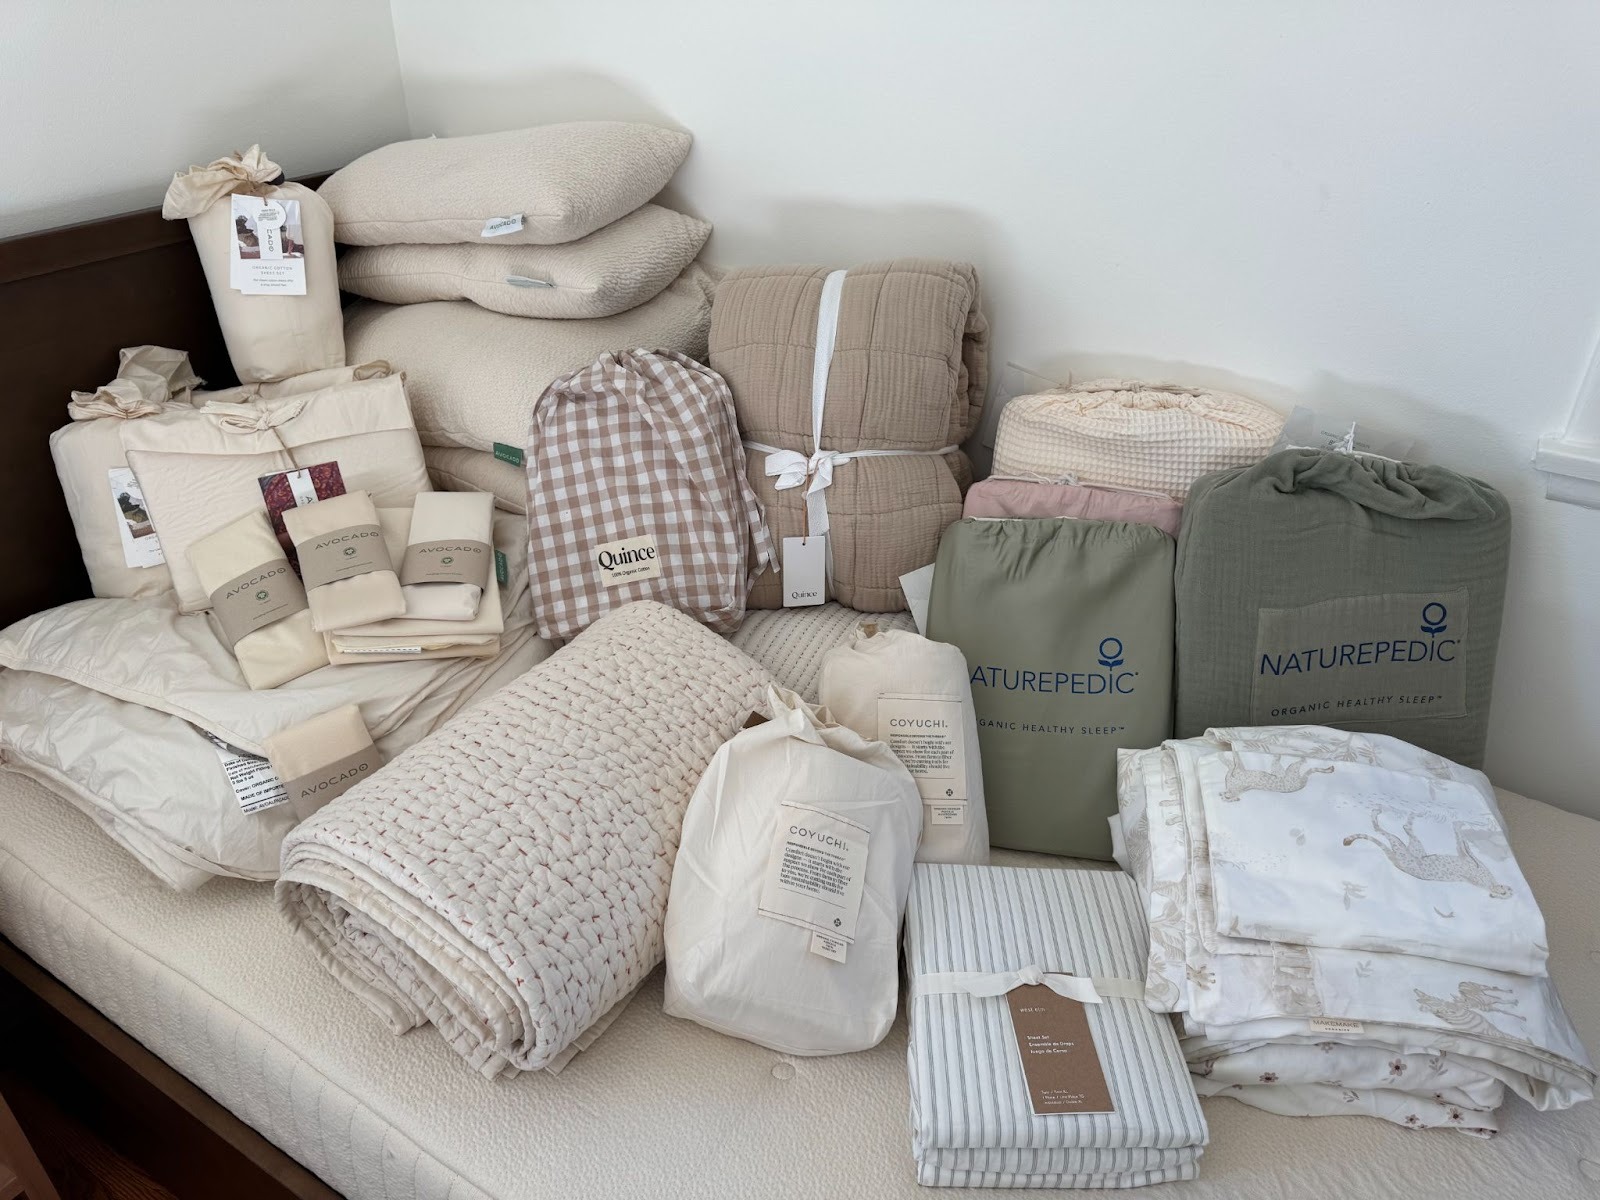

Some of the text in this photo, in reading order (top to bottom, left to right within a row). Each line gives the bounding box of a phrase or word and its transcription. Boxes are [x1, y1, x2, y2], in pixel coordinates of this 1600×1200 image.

[315, 532, 379, 550] AVOCADO
[598, 546, 655, 570] Quince
[226, 567, 286, 599] AVOCADO
[792, 591, 818, 599] Quince
[970, 666, 1134, 695] ATUREPEDIC
[1271, 701, 1330, 717] ORGANIC
[1337, 696, 1394, 708] HEALTHY
[978, 718, 1016, 730] GANIC
[1022, 724, 1075, 734] HEALTHY
[252, 778, 273, 787] ORGANIC
[301, 763, 368, 798] AVOCADO
